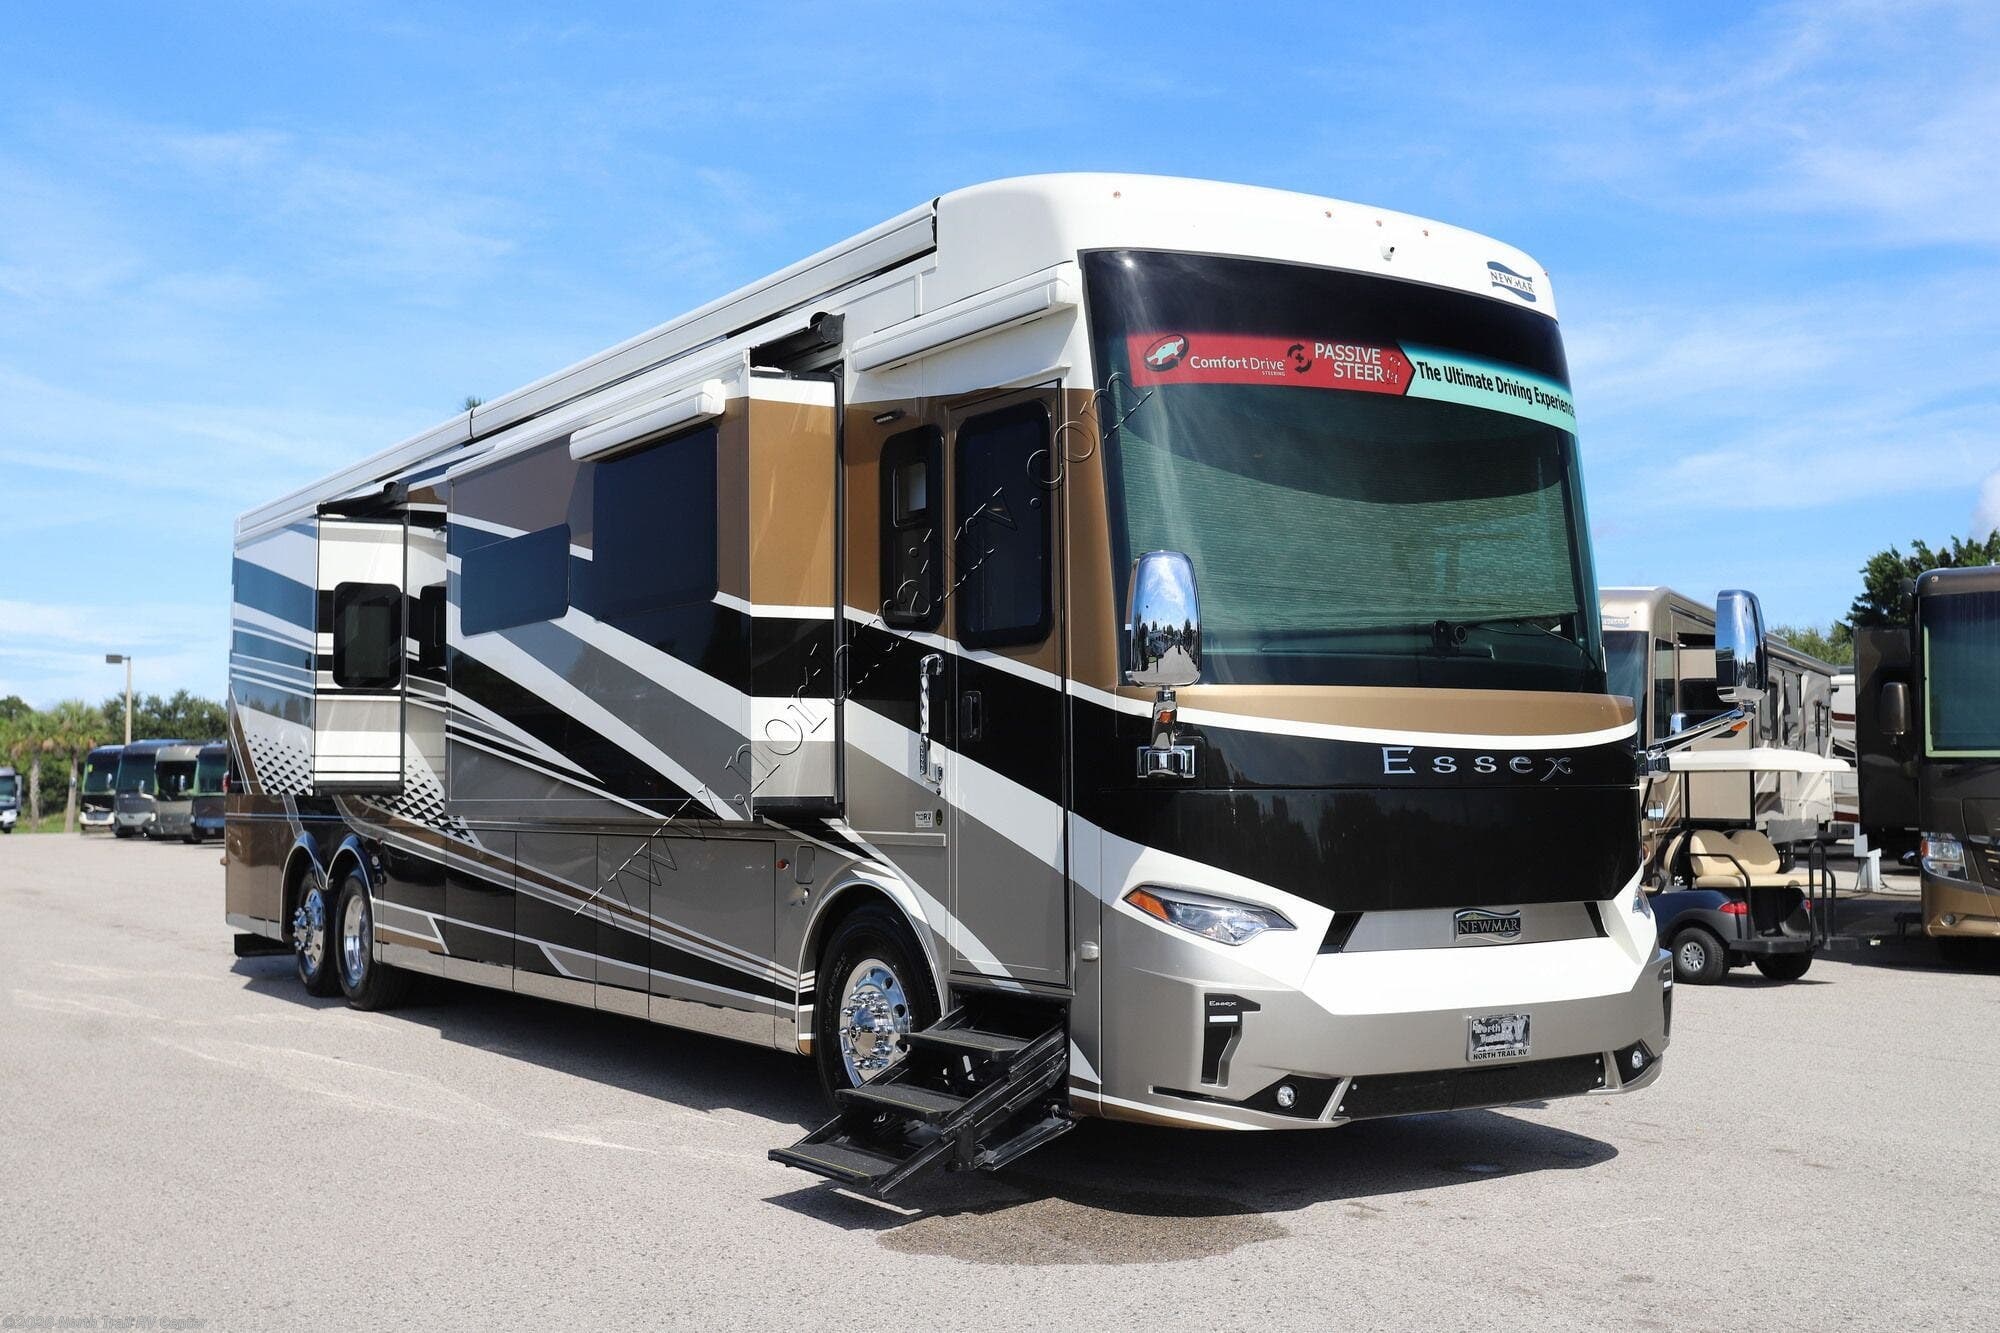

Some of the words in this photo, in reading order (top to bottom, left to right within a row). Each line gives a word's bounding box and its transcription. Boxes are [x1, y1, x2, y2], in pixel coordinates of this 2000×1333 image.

[1490, 271, 1535, 293] NEWMAR
[1190, 356, 1248, 369] Comfort
[1250, 357, 1284, 371] Drive
[1314, 342, 1382, 365] PASSIVE
[1333, 361, 1385, 382] STEER
[1417, 361, 1442, 382] The
[1443, 365, 1494, 391] Ultimate
[1496, 376, 1533, 406] Driving
[1381, 746, 1573, 782] Essex
[1459, 919, 1520, 933] NEWMAR
[1473, 1052, 1496, 1060] NORTH
[1497, 1050, 1516, 1058] TRAIL
